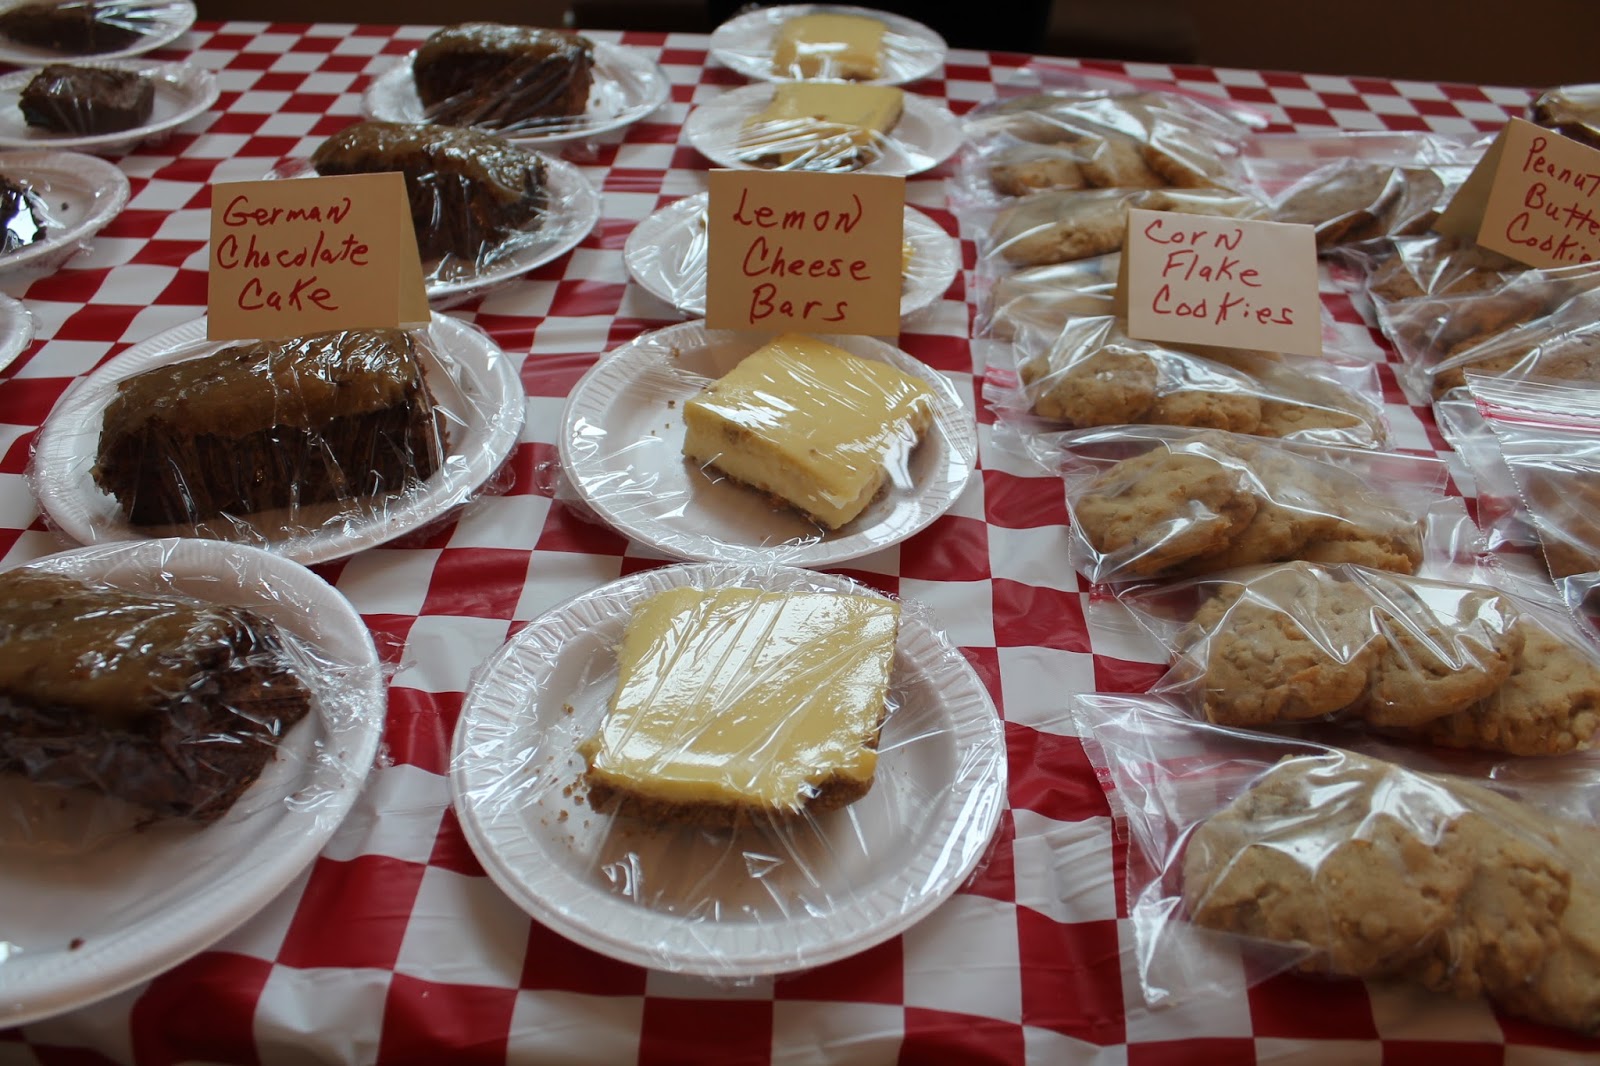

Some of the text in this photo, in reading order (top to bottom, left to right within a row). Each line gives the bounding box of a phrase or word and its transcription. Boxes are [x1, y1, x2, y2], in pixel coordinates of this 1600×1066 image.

[223, 195, 351, 227] German
[733, 188, 862, 234] Lemon
[1525, 182, 1600, 240] Butte
[217, 230, 369, 269] Chocolate
[1144, 219, 1243, 250] Corn
[1506, 212, 1600, 264] Cookie
[742, 236, 871, 281] Cheese
[1162, 249, 1262, 287] Flake
[238, 276, 339, 311] Cake
[750, 283, 848, 324] Bars
[1152, 284, 1293, 325] Cookies
